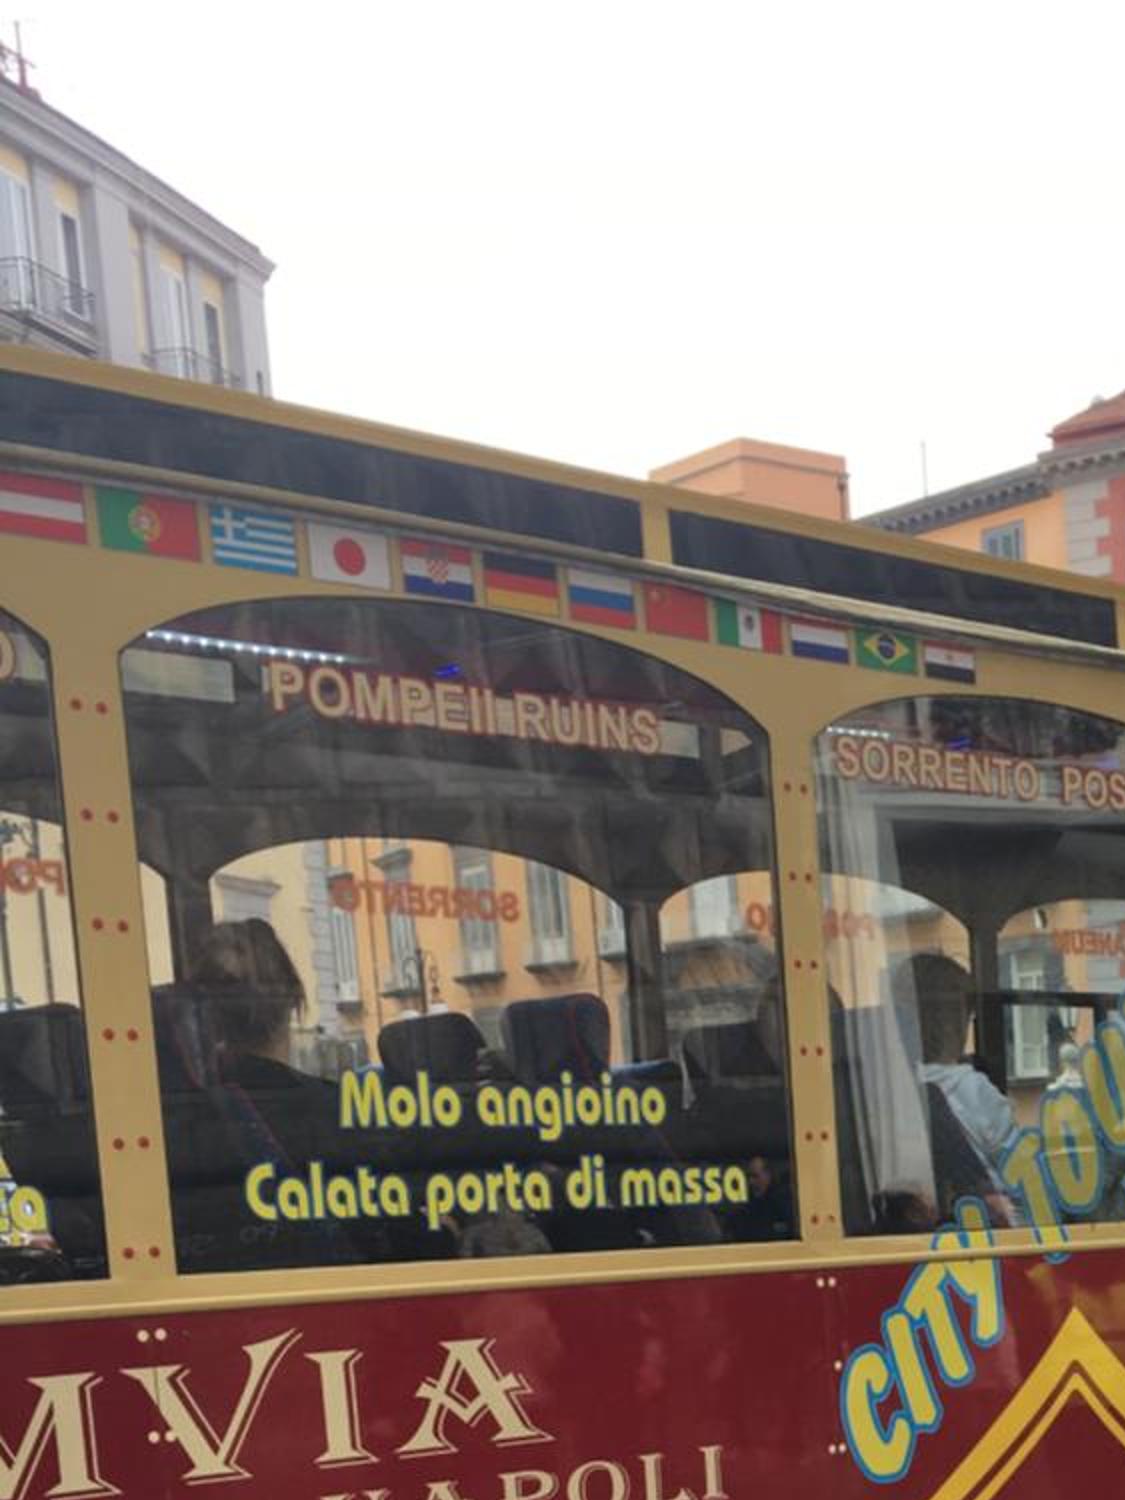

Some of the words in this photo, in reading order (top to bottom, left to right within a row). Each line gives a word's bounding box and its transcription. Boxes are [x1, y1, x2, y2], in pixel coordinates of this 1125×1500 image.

[270, 662, 496, 737] POMPEII
[513, 693, 661, 755] RUINS
[836, 735, 1039, 801] SORRENTO
[340, 1070, 461, 1129] Molo
[477, 1071, 666, 1142] angioino
[245, 1161, 411, 1221] Calata
[427, 1163, 551, 1230] porta
[566, 1155, 607, 1209] di
[621, 1165, 749, 1206] massa
[841, 1197, 1002, 1484] CITY
